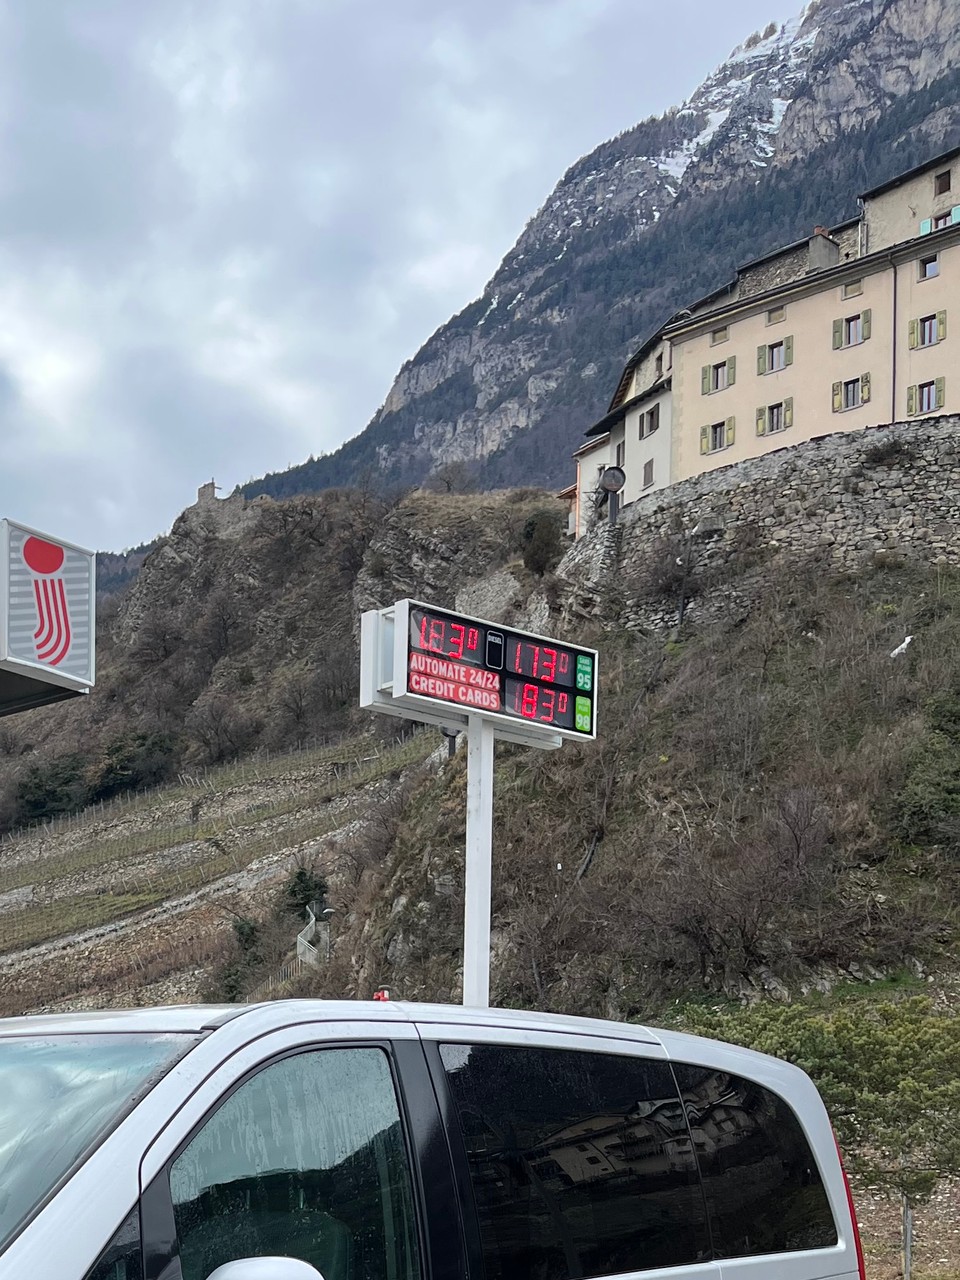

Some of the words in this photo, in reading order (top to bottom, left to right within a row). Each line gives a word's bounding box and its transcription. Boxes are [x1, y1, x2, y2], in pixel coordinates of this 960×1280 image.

[410, 654, 467, 682] AUTOMATE
[469, 669, 500, 690] 24/24
[576, 672, 592, 690] 95
[411, 674, 456, 698] CREDIT
[458, 686, 498, 708] CARDS
[576, 713, 591, 730] 98
